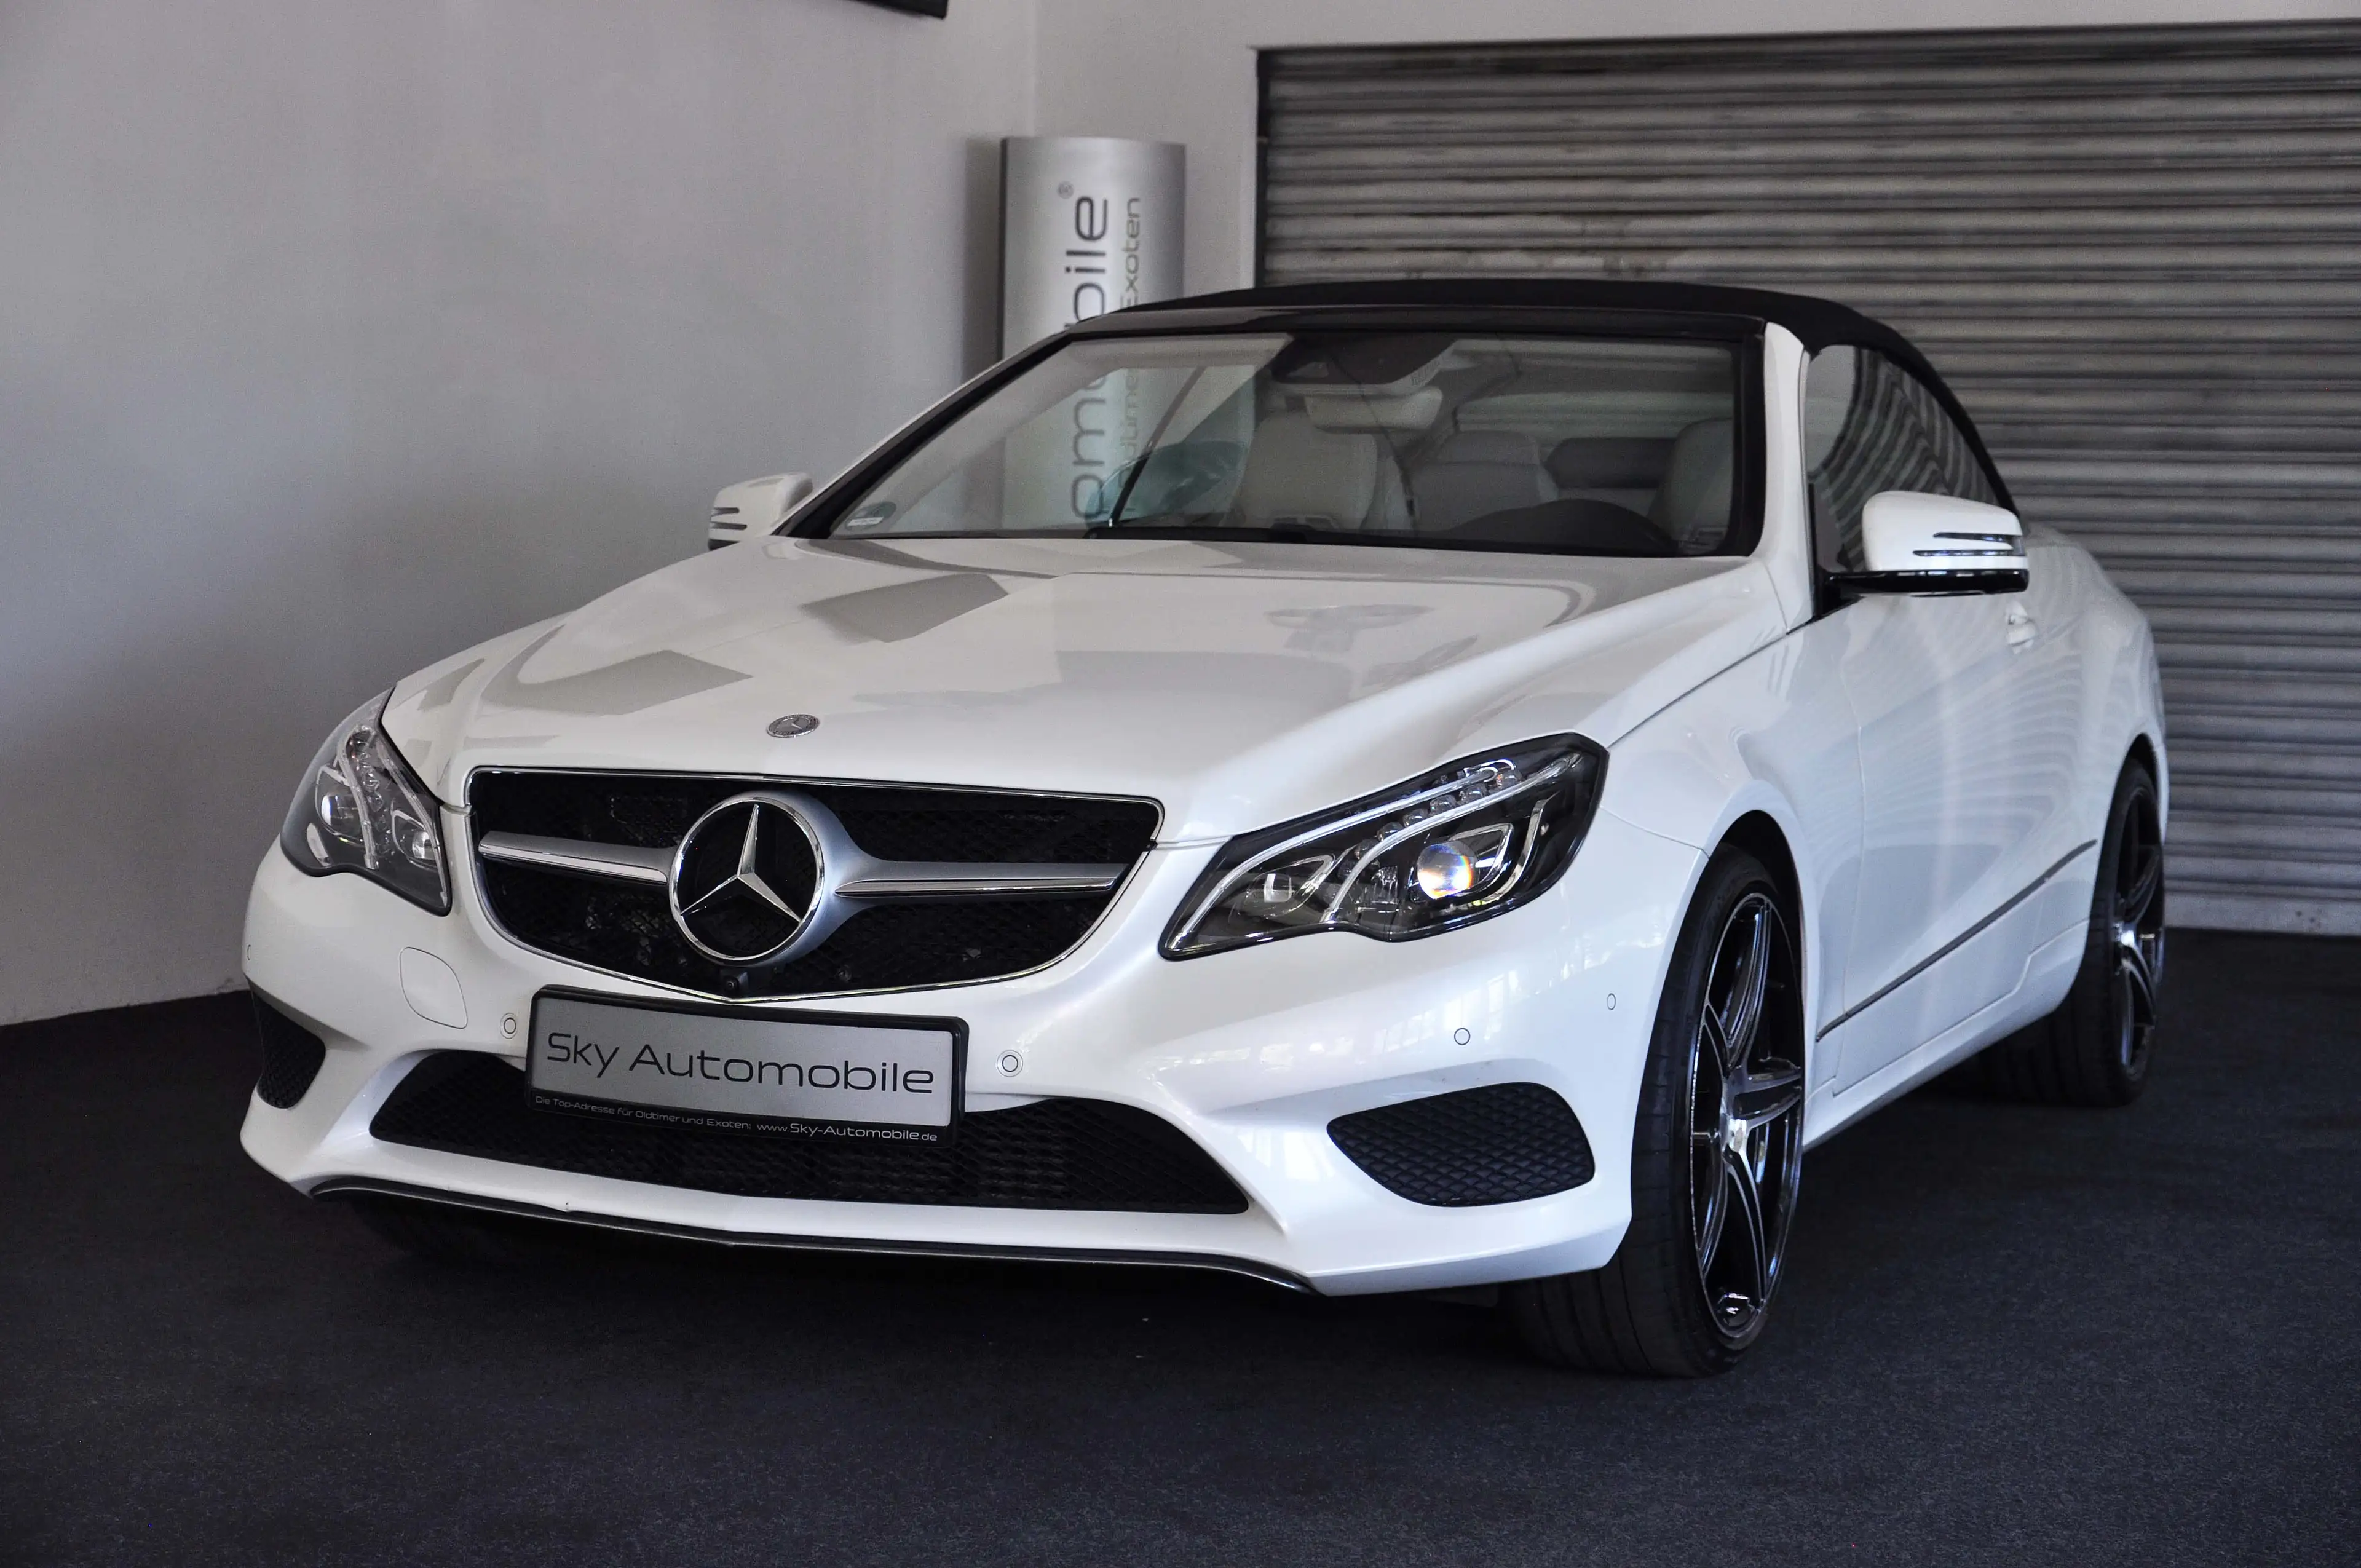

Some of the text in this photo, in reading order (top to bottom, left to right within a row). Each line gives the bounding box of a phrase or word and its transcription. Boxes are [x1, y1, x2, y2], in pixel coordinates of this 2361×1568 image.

[547, 1032, 934, 1094] Sky Automobile
[535, 1095, 550, 1105] Die
[552, 1098, 615, 1115] Top-Adresse
[635, 1111, 680, 1122] Oldtimer
[706, 1118, 751, 1130] Exoten:
[757, 1123, 938, 1142] www.Sky-Automobile.de
